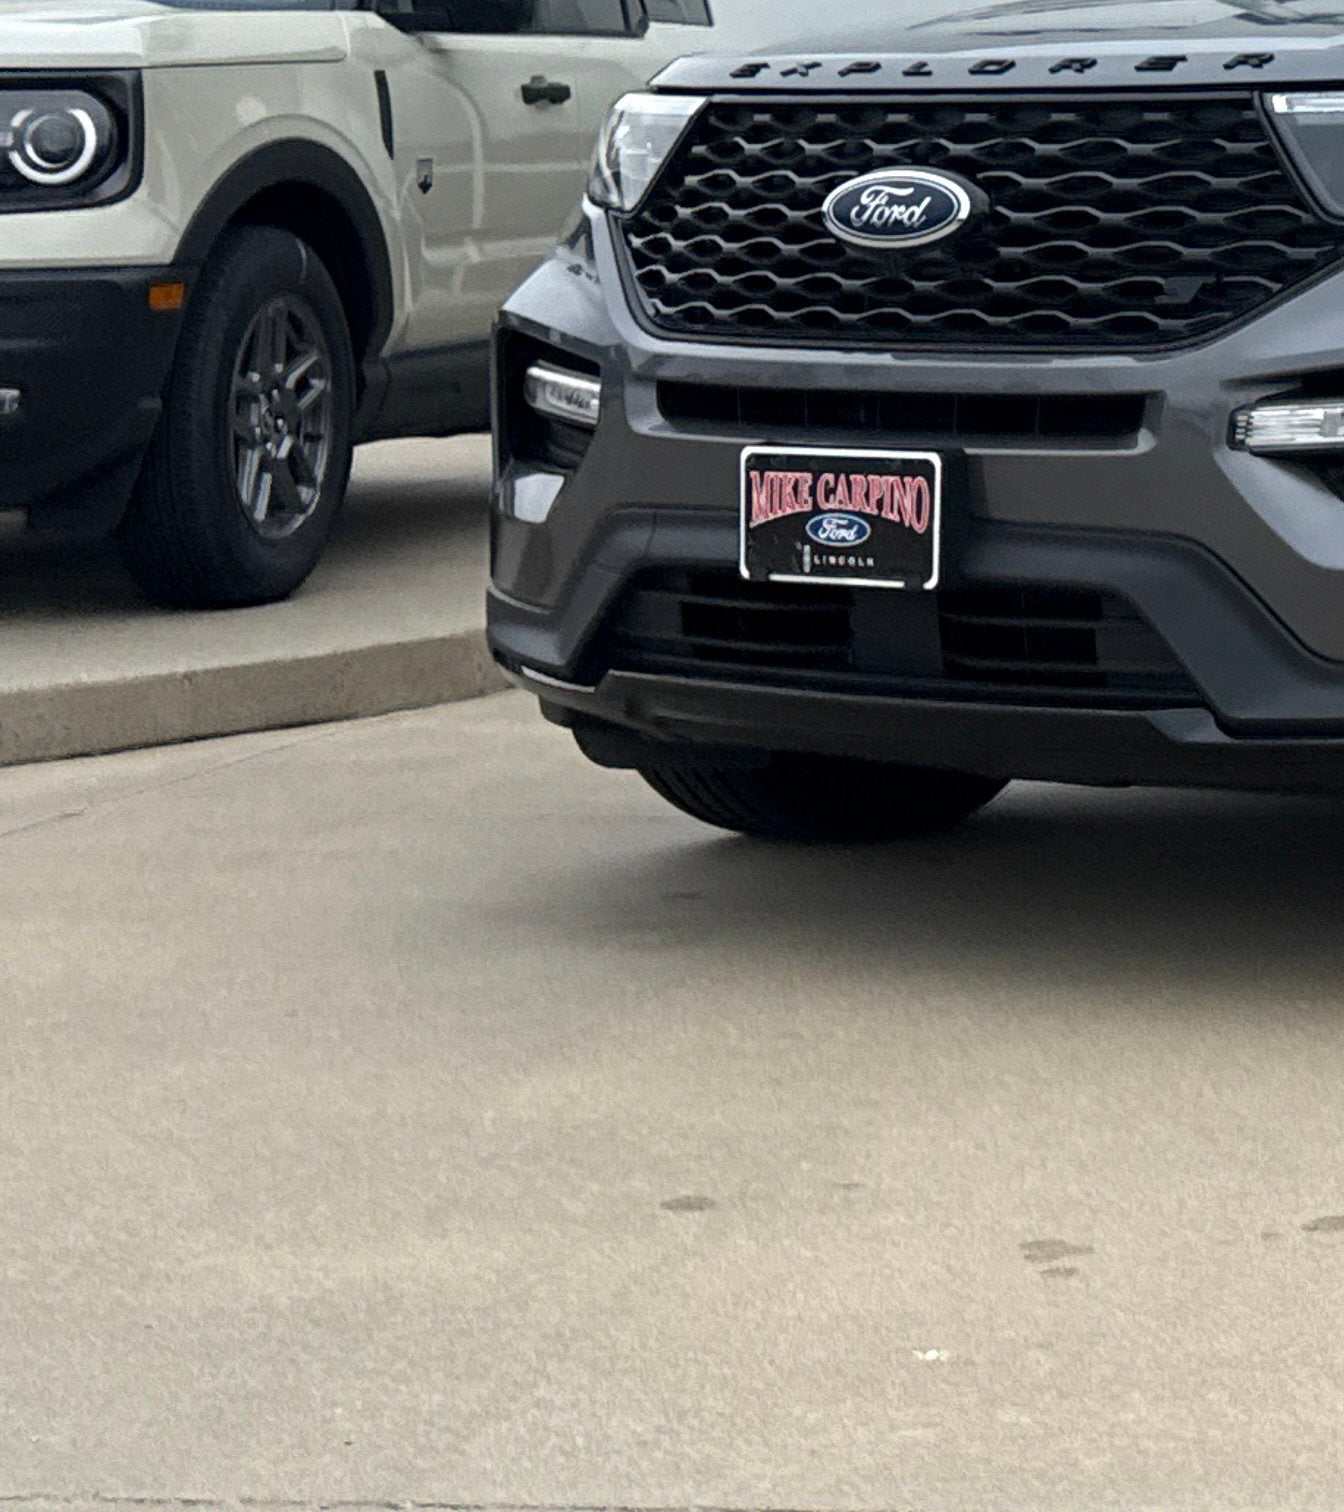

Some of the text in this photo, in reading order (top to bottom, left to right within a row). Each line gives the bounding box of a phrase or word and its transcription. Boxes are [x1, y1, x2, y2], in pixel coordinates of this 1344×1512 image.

[729, 53, 1274, 78] EXPLORER
[851, 185, 932, 227] Ford
[750, 471, 930, 534] MIKE CARPINO
[818, 519, 859, 541] Ford
[813, 554, 875, 567] LINCOLN
